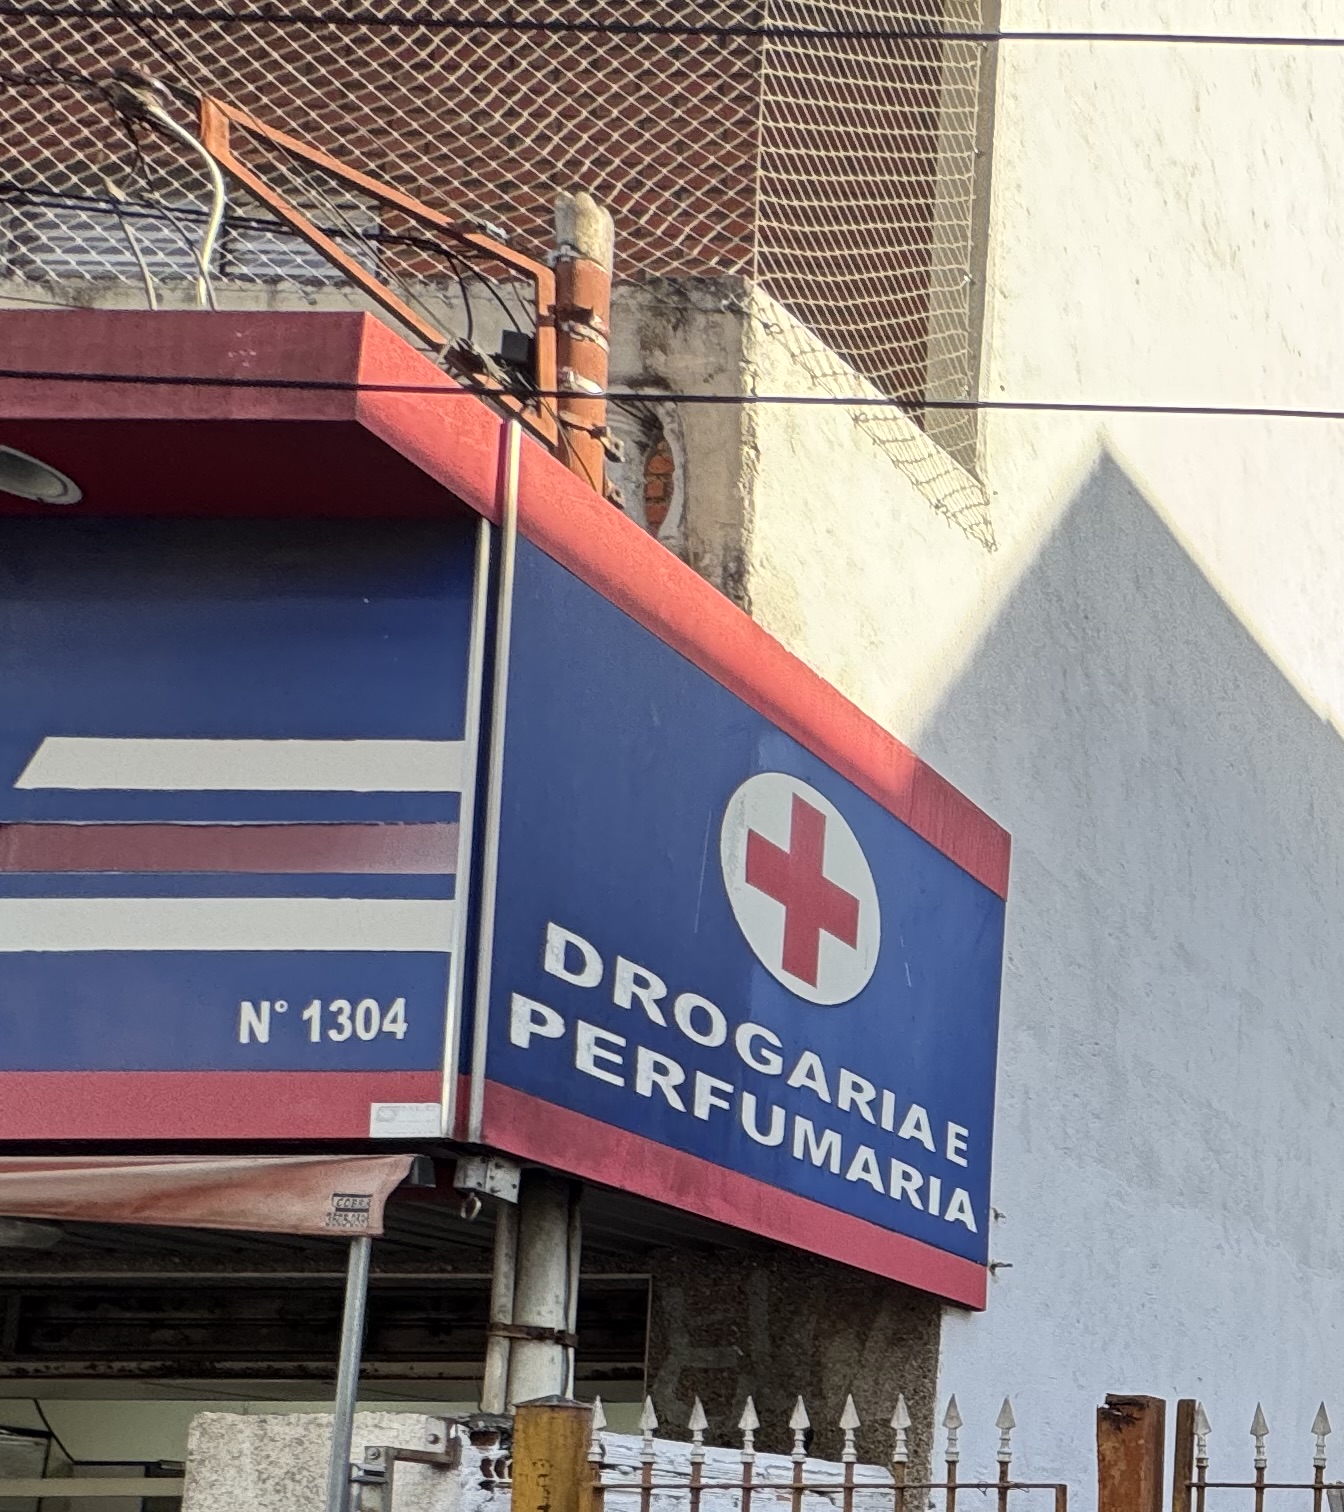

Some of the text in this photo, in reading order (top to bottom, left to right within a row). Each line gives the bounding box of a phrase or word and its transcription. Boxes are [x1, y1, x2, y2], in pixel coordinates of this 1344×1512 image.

[302, 997, 408, 1043] 1304
[509, 992, 978, 1234] PERFUMARIA
[543, 921, 970, 1168] DROGARIA E
